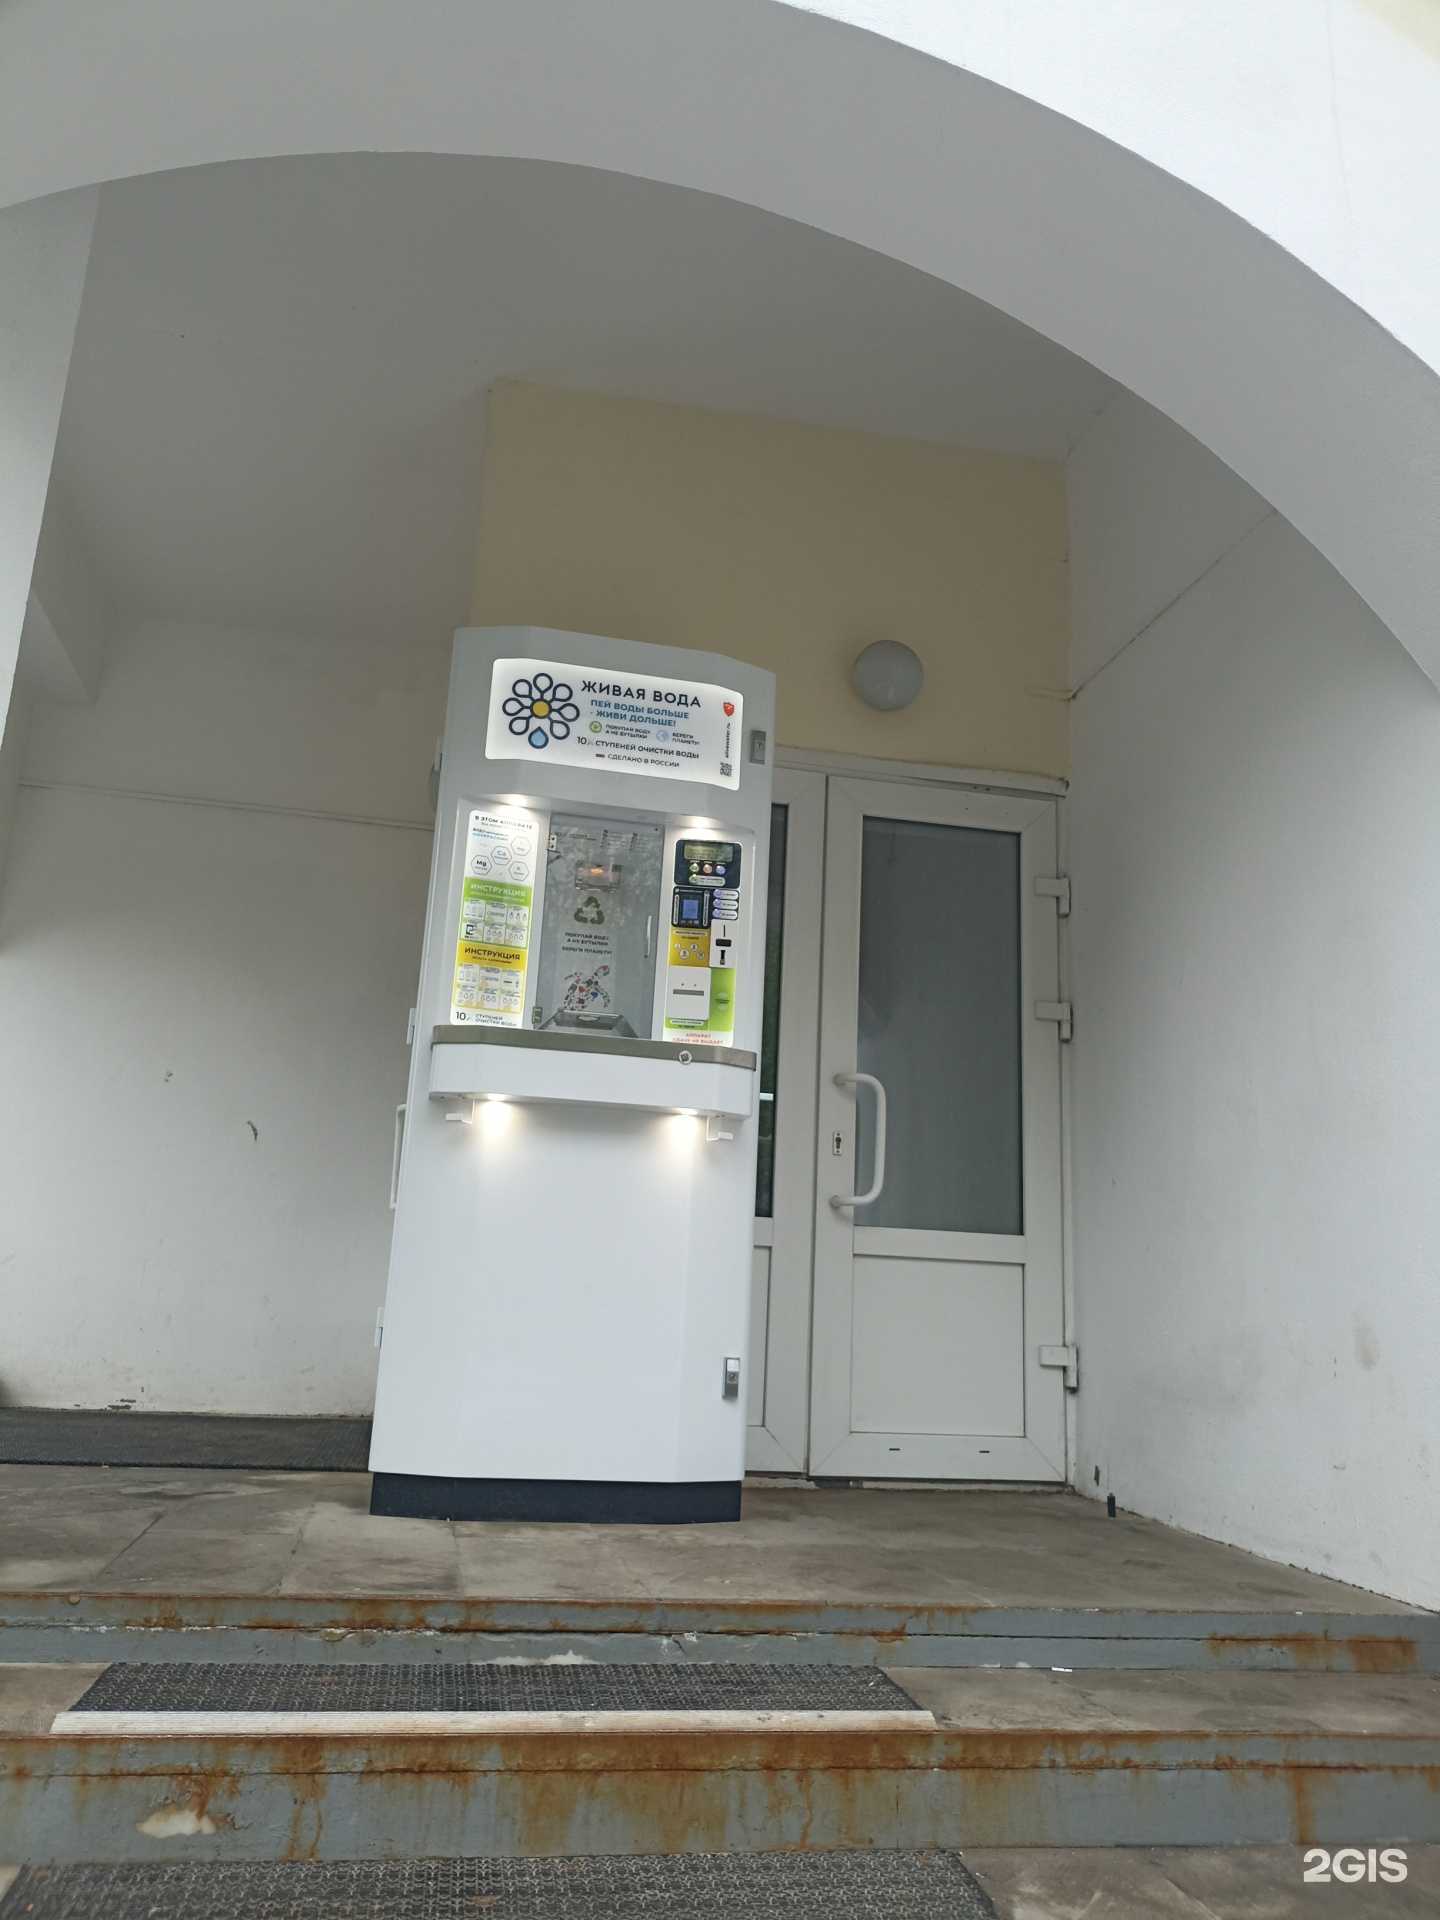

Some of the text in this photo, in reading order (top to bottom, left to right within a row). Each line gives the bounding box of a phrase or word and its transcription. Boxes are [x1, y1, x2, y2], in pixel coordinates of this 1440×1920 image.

[581, 680, 701, 708] ЖИВАЯ ВОДА
[590, 699, 689, 719] ПЕЙ ВОДЫ БОЛЬШЕ
[596, 710, 627, 720] ЖИВИ
[629, 715, 676, 727] ДОЛЬШЕ!
[577, 736, 700, 760] 10 СТУПЕНЕЙ ОЧИСТКИ ВОДЫ
[607, 753, 642, 764] СДЕЛАНО
[650, 759, 680, 768] РОССИИ
[464, 947, 521, 961] ИНСТРУКЦИЯ
[456, 1011, 466, 1021] 10
